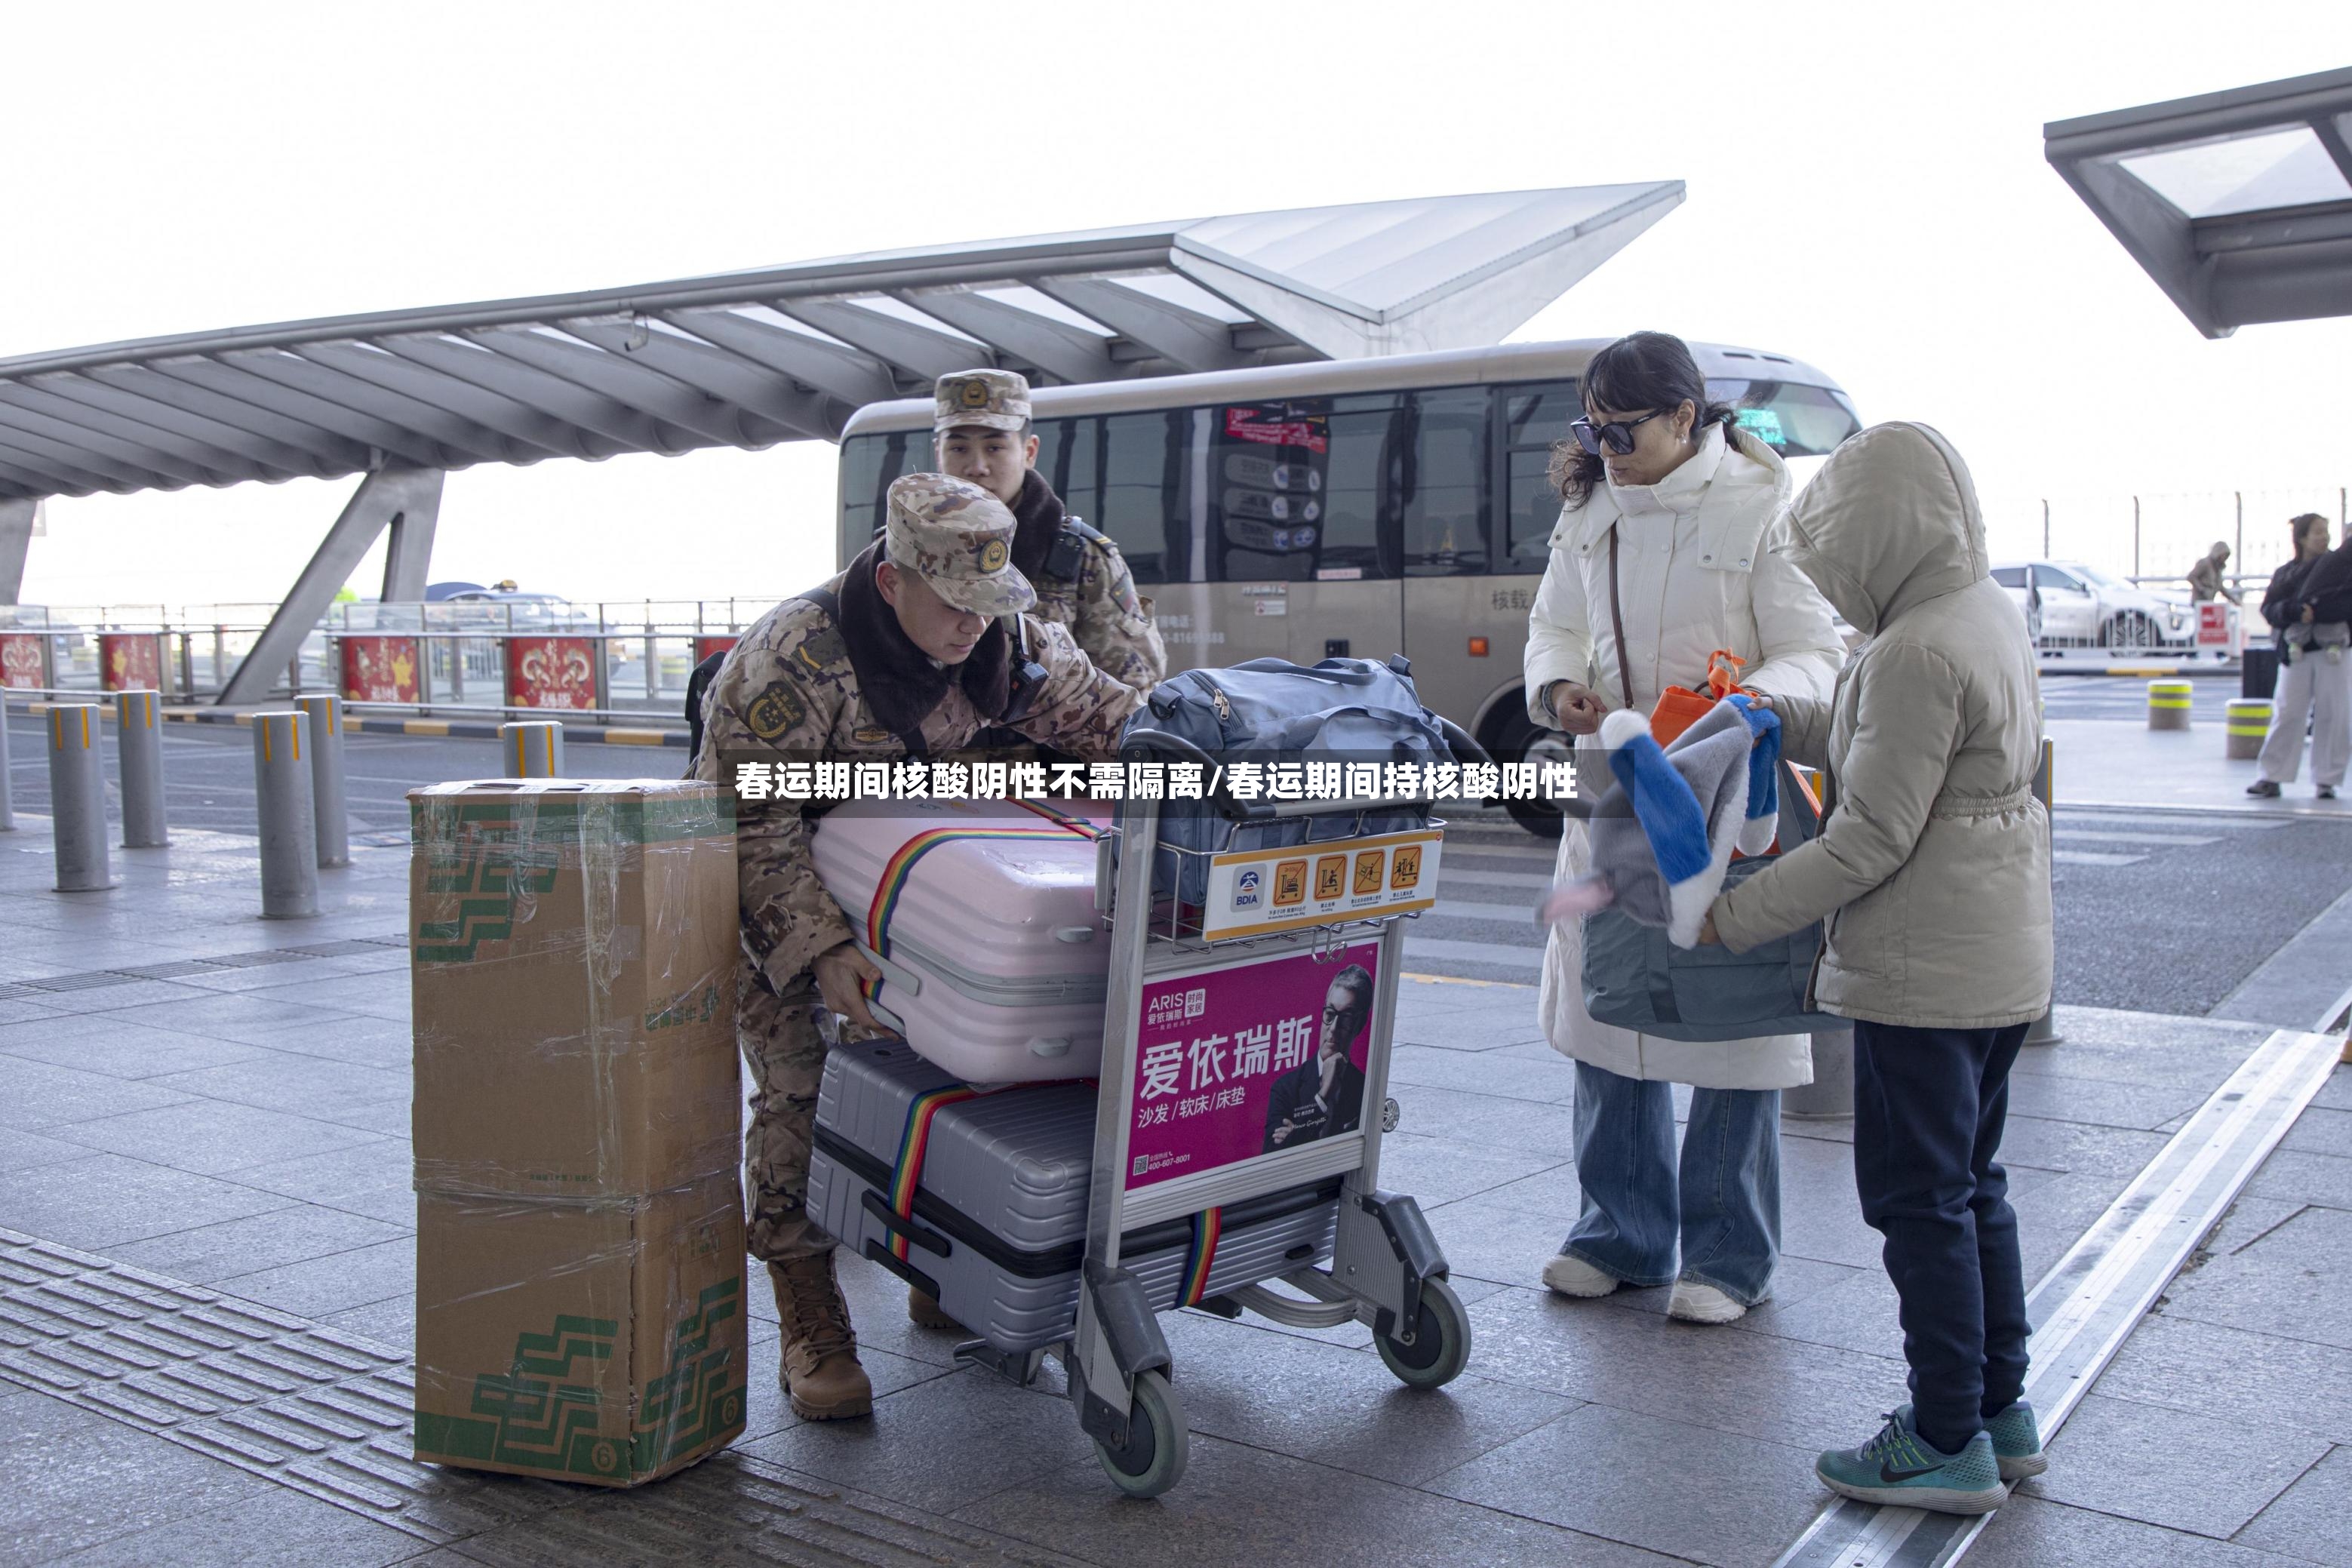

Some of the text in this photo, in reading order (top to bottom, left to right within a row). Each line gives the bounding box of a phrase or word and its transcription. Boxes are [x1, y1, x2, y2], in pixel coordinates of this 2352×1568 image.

[1492, 589, 1529, 611] 核载
[1236, 895, 1258, 906] BDIA
[1148, 993, 1184, 1013] ARIS
[1188, 992, 1203, 1004] 时尚
[1187, 1002, 1202, 1015] 家居
[1147, 1009, 1182, 1025] 爱依瑞斯
[1139, 1015, 1313, 1101] 爱依瑞斯
[1148, 1154, 1191, 1170] 400-607-8001
[596, 1445, 612, 1465] 6
